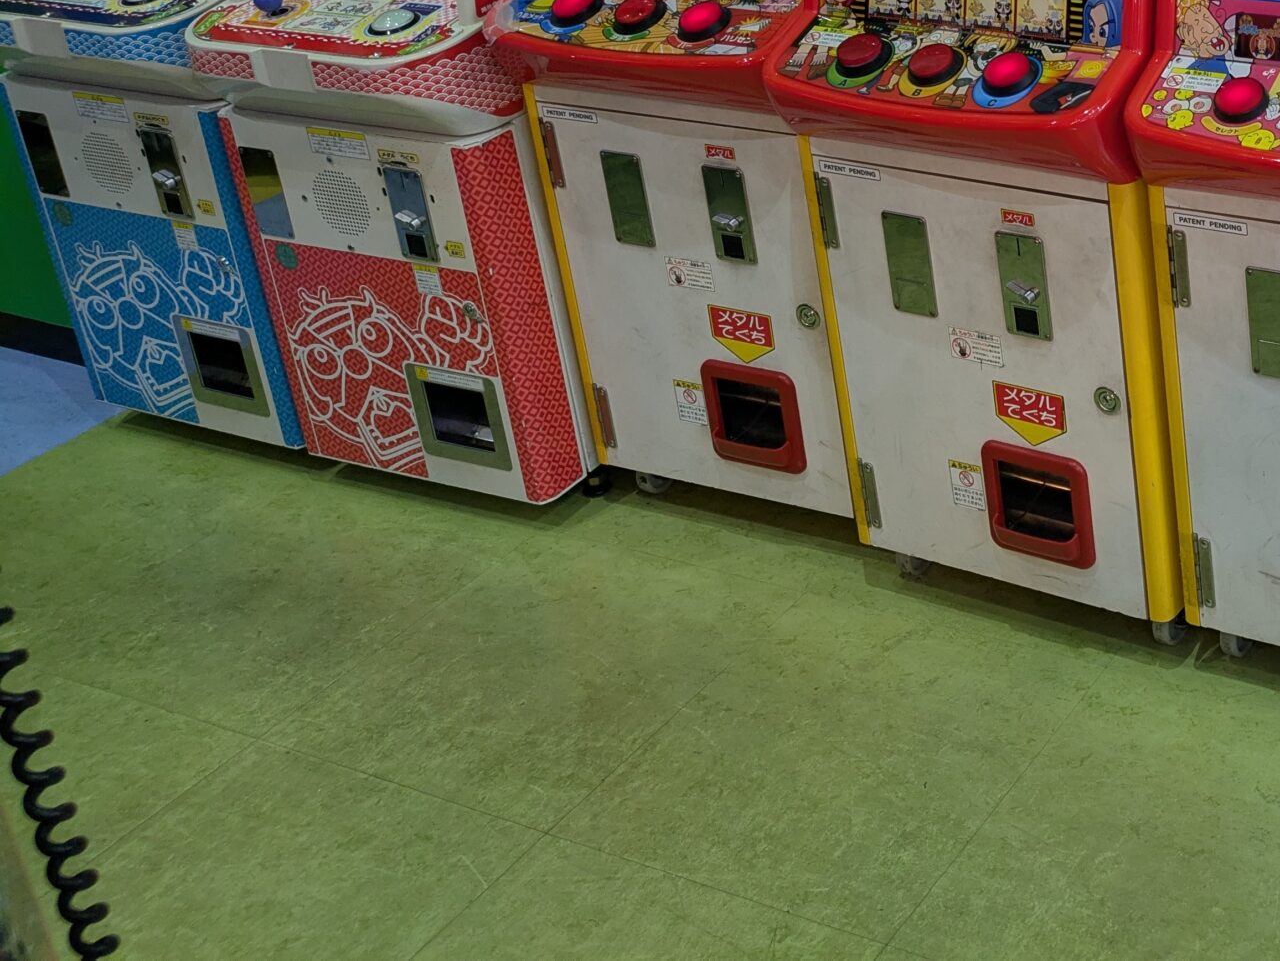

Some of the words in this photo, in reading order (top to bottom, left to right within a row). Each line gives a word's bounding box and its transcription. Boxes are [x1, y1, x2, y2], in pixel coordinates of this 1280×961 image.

[838, 79, 848, 87] A
[911, 88, 922, 96] B
[987, 98, 997, 107] C
[546, 109, 567, 117] PATENT
[569, 111, 594, 121] PENDING
[1215, 127, 1240, 135] セレクト
[824, 164, 846, 174] PATENT
[849, 167, 877, 178] PENDING
[1178, 216, 1206, 226] PATENT
[1209, 220, 1243, 233] PENDING
[718, 311, 764, 330] メダル
[719, 324, 765, 345] でぐち
[1004, 387, 1056, 411] メダル
[1004, 404, 1057, 428] でぐち
